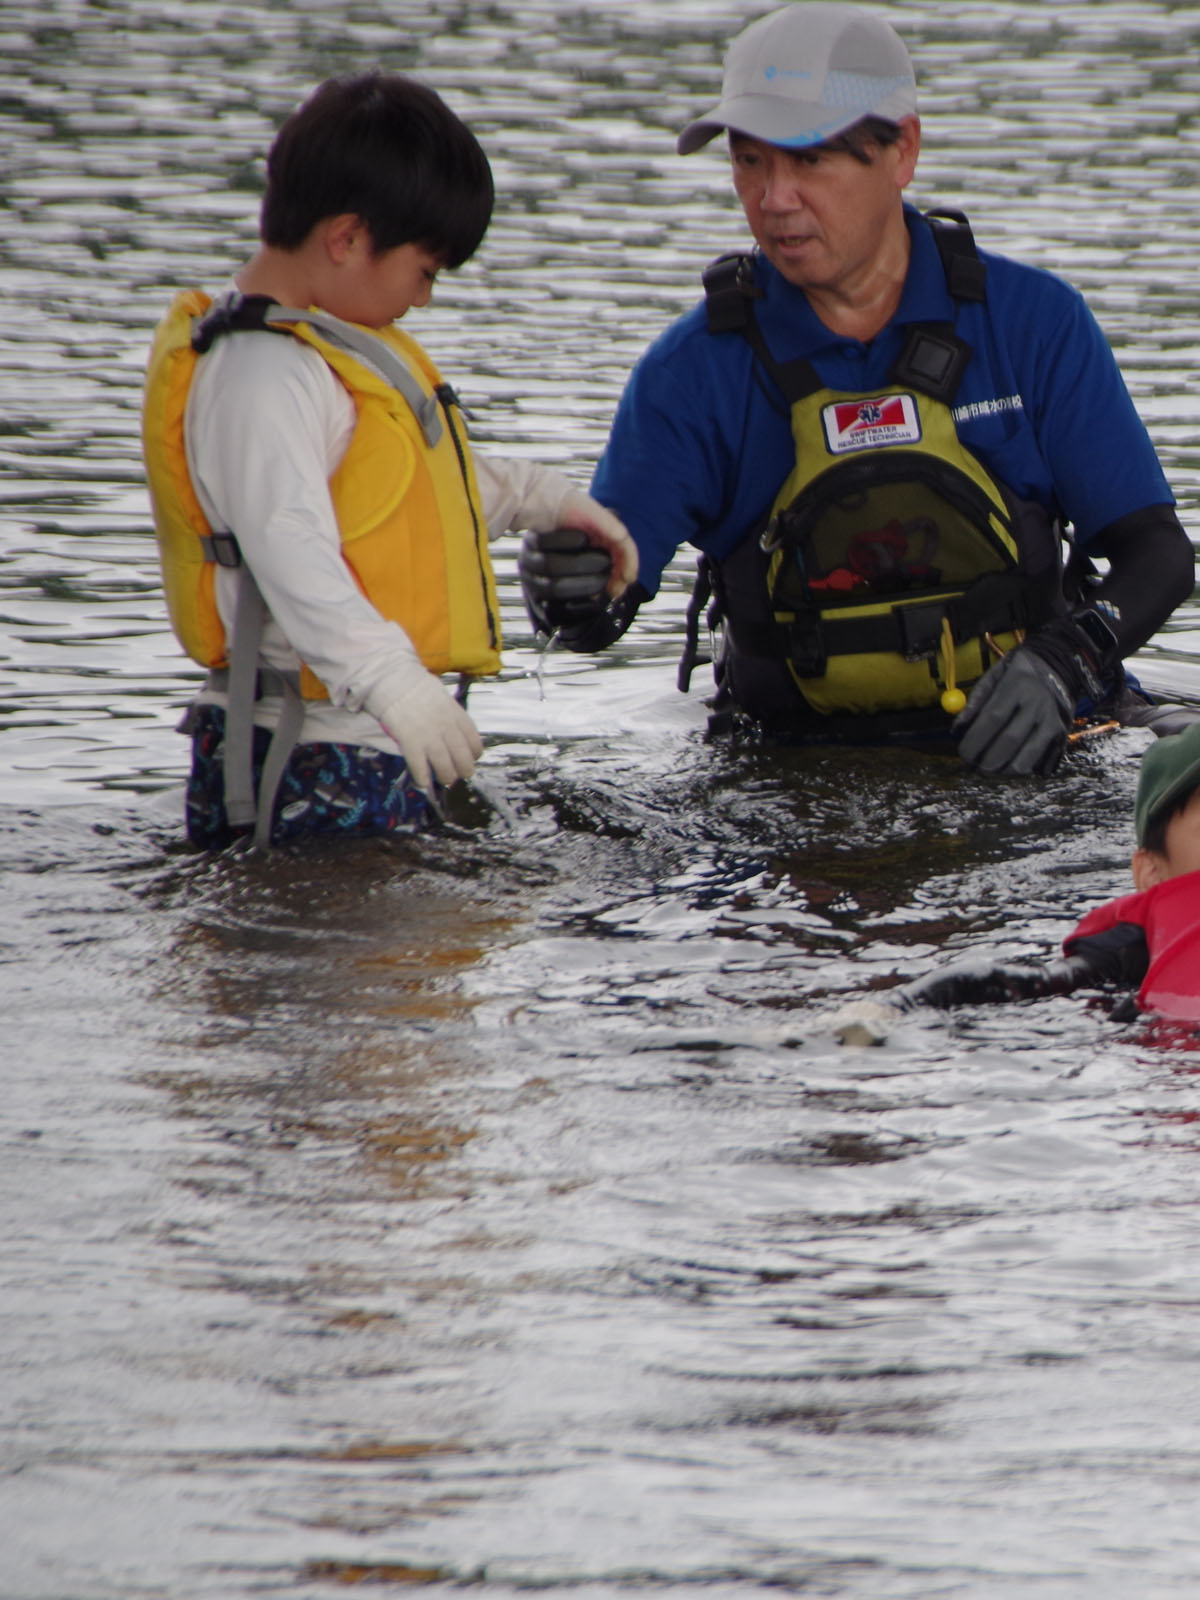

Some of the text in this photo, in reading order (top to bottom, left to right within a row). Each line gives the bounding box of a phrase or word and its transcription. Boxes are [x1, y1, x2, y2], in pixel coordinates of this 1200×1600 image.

[849, 426, 897, 438] SWIFTWATER
[838, 431, 911, 448] RESCUE TECHNICIAN
